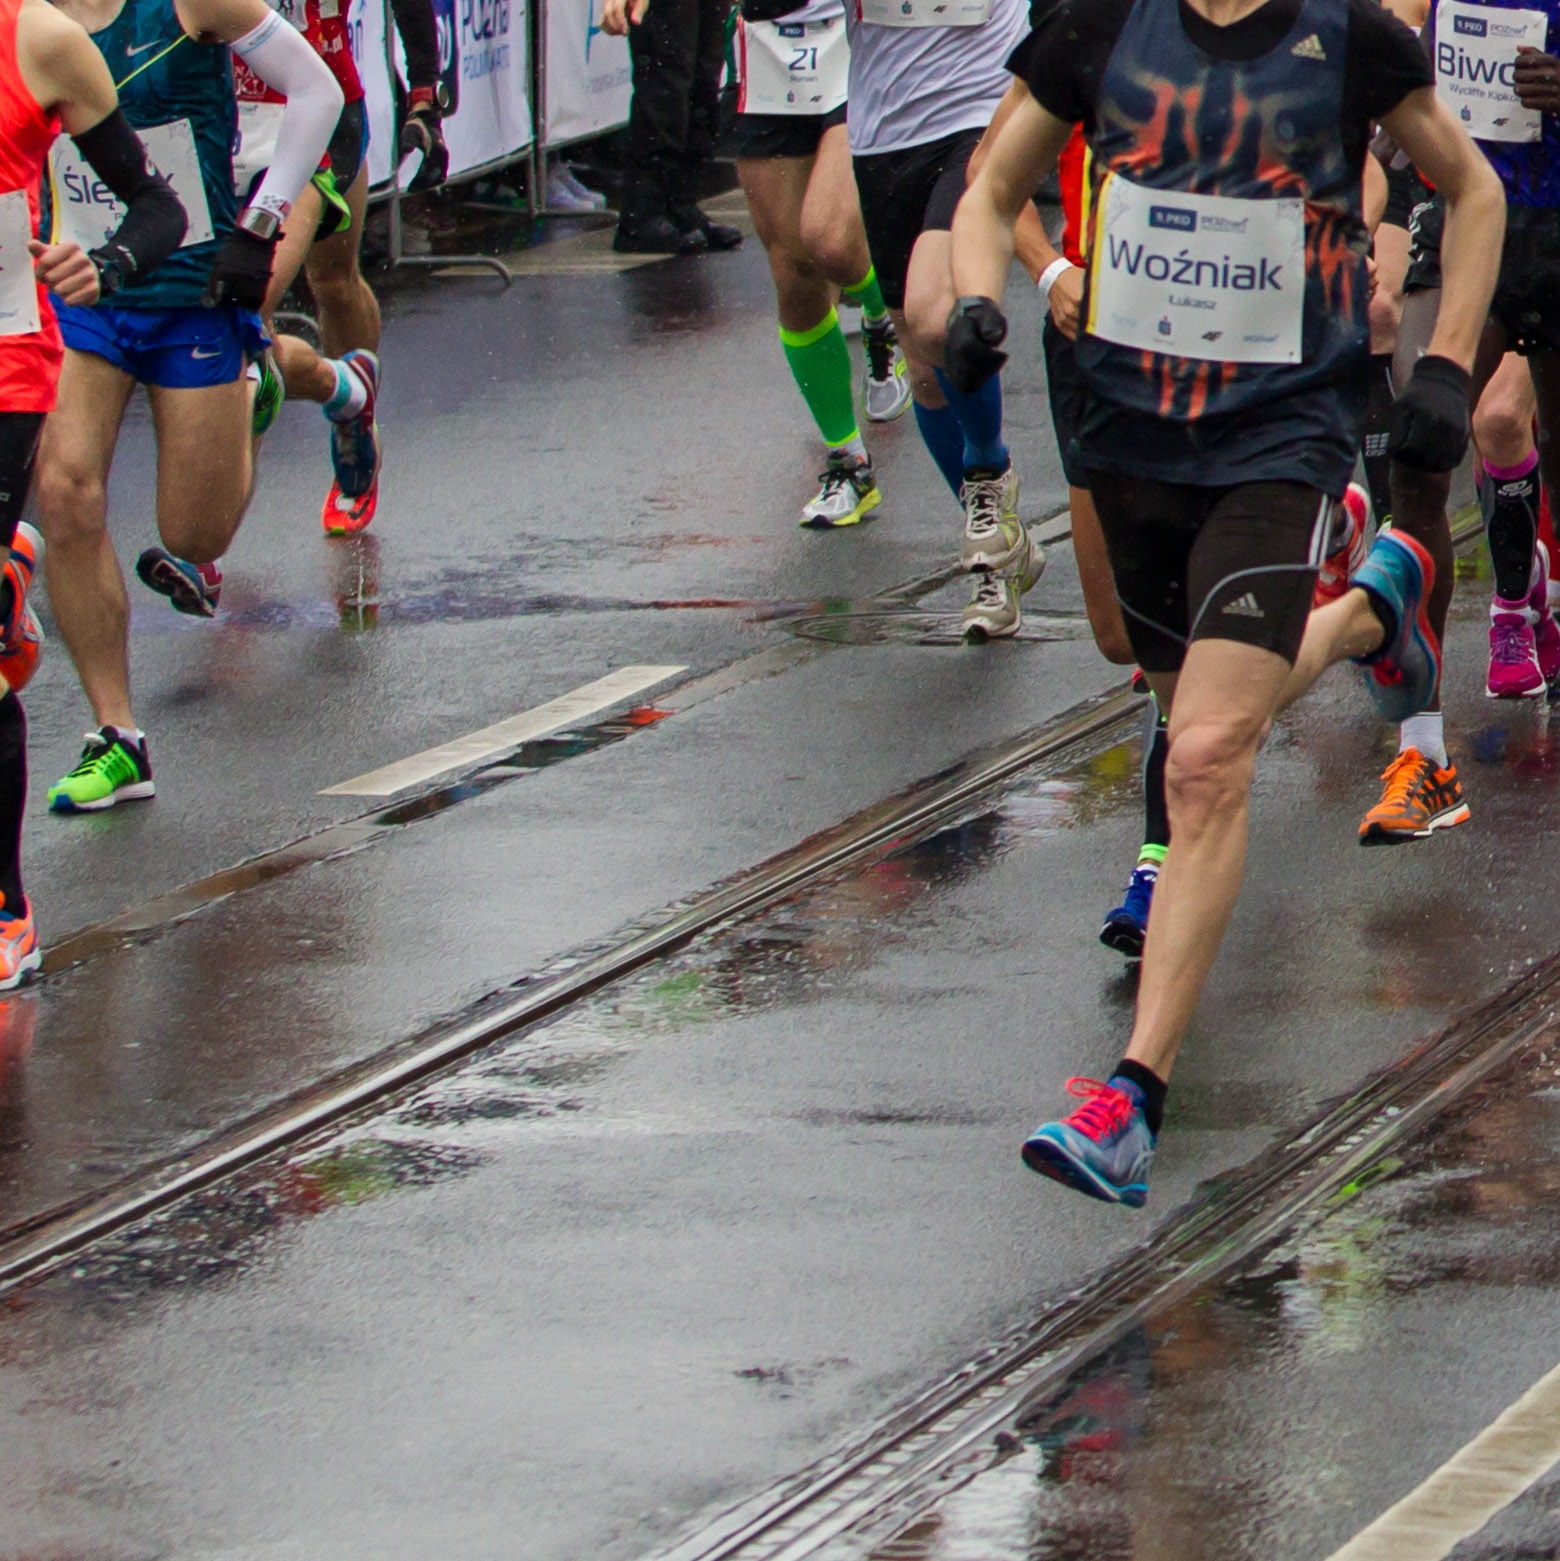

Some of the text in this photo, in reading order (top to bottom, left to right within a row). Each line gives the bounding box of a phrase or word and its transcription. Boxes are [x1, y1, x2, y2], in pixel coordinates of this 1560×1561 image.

[789, 47, 818, 71] 21
[1108, 233, 1283, 291] Woźniak
[1168, 294, 1217, 310] Łukasz
